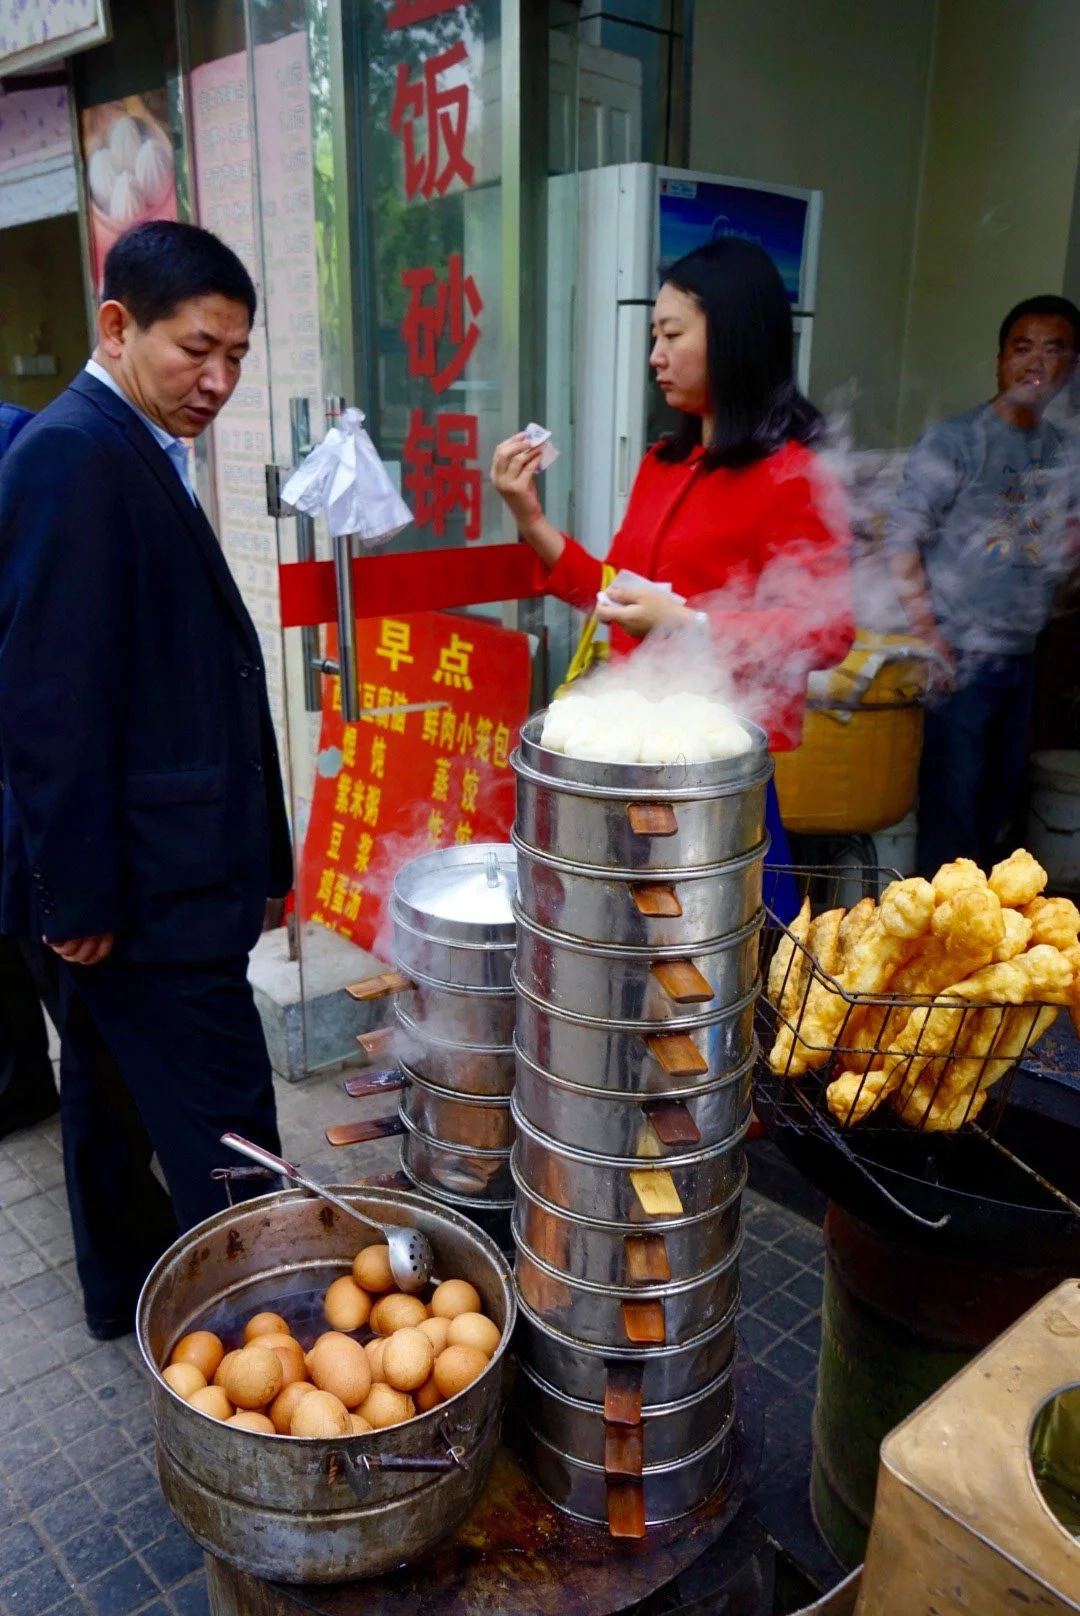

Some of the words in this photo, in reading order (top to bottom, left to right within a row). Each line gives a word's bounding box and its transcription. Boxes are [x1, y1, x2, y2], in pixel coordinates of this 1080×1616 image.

[386, 0, 476, 202] 饭
[401, 253, 484, 541] 砂锅
[376, 618, 474, 691] 早点
[326, 821, 373, 873] 豆浆
